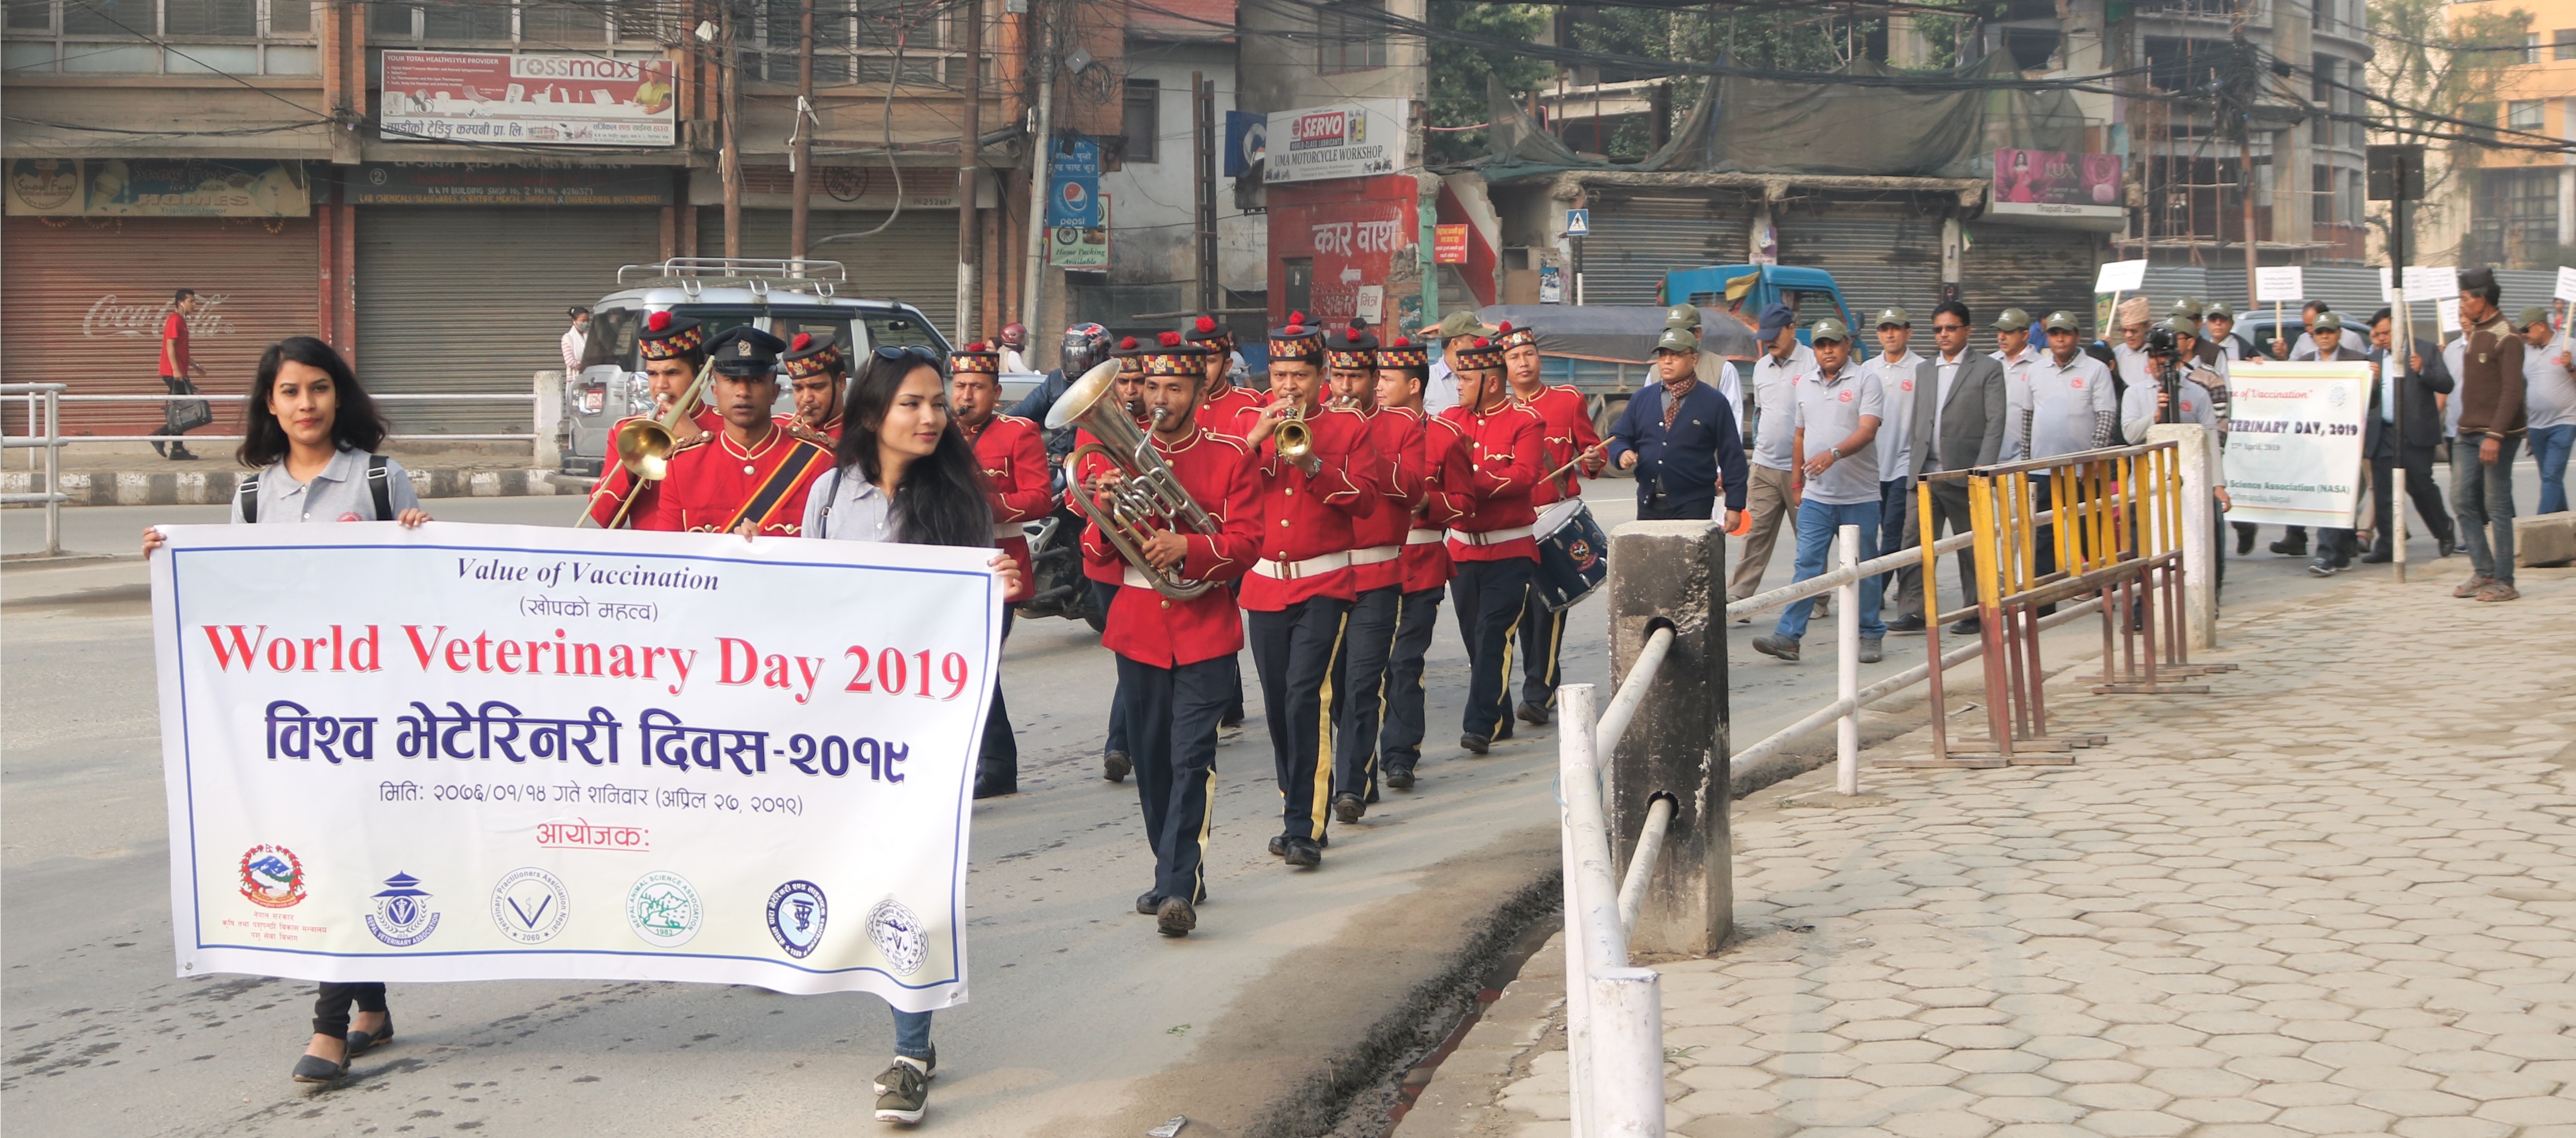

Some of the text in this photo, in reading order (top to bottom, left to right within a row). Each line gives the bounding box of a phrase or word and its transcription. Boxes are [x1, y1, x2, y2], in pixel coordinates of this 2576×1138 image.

[516, 57, 633, 78] rossmax
[456, 122, 491, 136] कम्पनी
[493, 124, 506, 137] प्रा.
[509, 122, 523, 136] लि.
[593, 122, 617, 130] सर्जिकल
[1303, 115, 1343, 138] SERVO
[1291, 138, 1343, 150] WORLD-CLASS LUBRICANTS
[1275, 145, 1383, 167] UMA MOTORCYCLE WORKSHOP
[374, 170, 382, 181] 2
[2046, 163, 2078, 179] LUX
[18, 178, 74, 191] Snow Fun
[138, 193, 250, 206] HOMES
[359, 194, 373, 202] LAB
[2064, 204, 2082, 214] Store
[1060, 217, 1085, 226] pepsi
[1312, 219, 1401, 257] कार वाश
[1078, 249, 1105, 257] Packing
[1360, 292, 1378, 307] भित्र
[2241, 388, 2249, 401] of
[2229, 419, 2358, 437] TERINARY DAY, 2019
[2230, 480, 2262, 489] Science
[2263, 482, 2316, 492] Association
[2317, 483, 2351, 494] (NASA)
[2270, 494, 2291, 504] Nepal
[457, 557, 719, 591] Value of Vaccination
[519, 593, 658, 623] (खोपको महत्व)
[201, 624, 969, 705] World Veterinary Day 2019
[264, 699, 910, 785] विश्व भेटेरिनरी दिवस-२०१९
[379, 780, 803, 816] मिति: २०७६/०१/१४ गते शनिवार (अप्रिल २७, २०१९)
[536, 817, 650, 847] आयोजक:
[496, 871, 541, 894] Practitioners
[629, 875, 700, 932] NEPAL ANIMAL SCIENCE ASSOCIATION
[254, 910, 294, 921] नेपाल सरकार
[494, 894, 510, 933] Veterinary
[222, 918, 235, 929] कृषि
[279, 921, 299, 931] विकास
[302, 925, 327, 934] मन्त्रालय
[366, 913, 439, 946] NEPAL VETERINARY ASSOCIATION
[551, 912, 567, 933] Nepal
[251, 931, 298, 942] पशु सेवा विभाग
[656, 929, 673, 937] 1983
